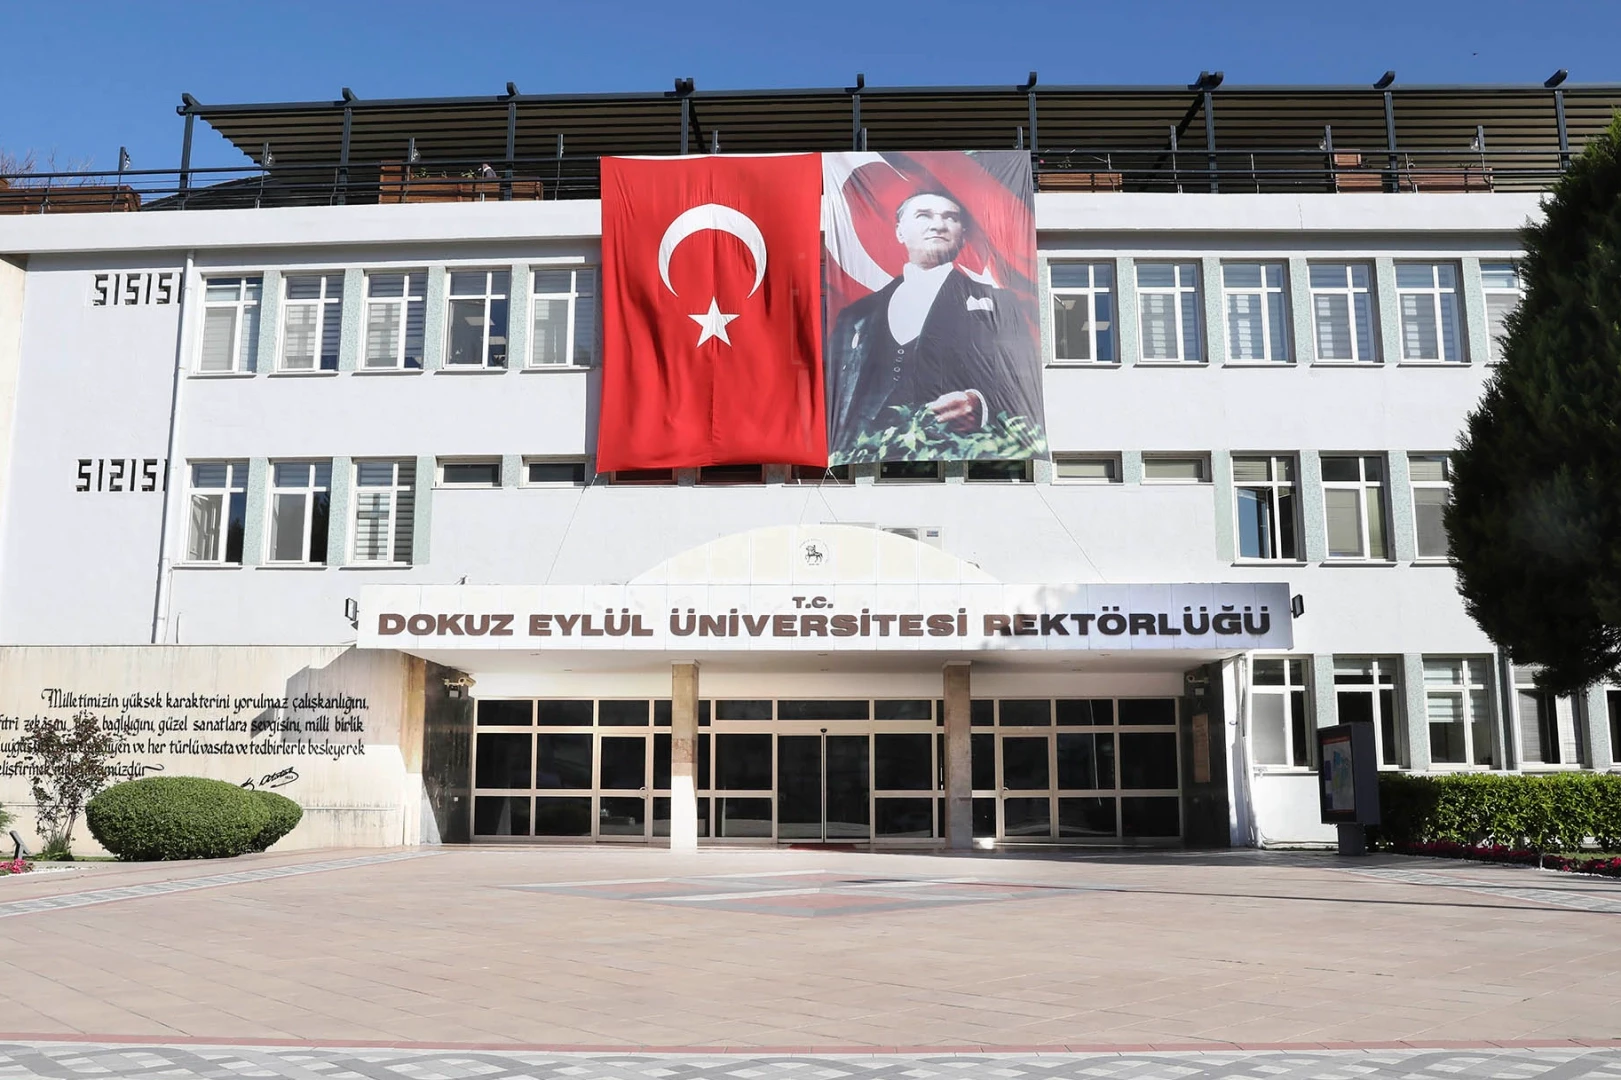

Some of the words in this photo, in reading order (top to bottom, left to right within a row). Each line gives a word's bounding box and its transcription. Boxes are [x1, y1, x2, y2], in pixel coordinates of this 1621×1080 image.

[792, 596, 834, 609] T.C.
[378, 613, 514, 637] DOKUZ
[528, 607, 654, 637] EYLÜL
[669, 607, 967, 637] ÜNİVERSİTESİ
[983, 605, 1270, 637] REKTÖRLÜĞÜ
[41, 688, 119, 708] Milletimizin
[121, 692, 162, 713] yüksek
[166, 692, 230, 709] karakterini
[233, 693, 289, 714] yorulmaz
[292, 693, 369, 714] çalışkanlığını,
[157, 715, 187, 736] güzel
[193, 716, 247, 732] sanatlara
[251, 717, 302, 737] sevgisini,
[335, 715, 364, 732] birlik
[133, 741, 145, 754] ve
[148, 738, 167, 754] her
[169, 738, 199, 754] türlü
[200, 740, 234, 754] vasıta
[235, 742, 248, 755] ve
[250, 738, 306, 755] tedbirlerle
[308, 738, 365, 761] besleyerek
